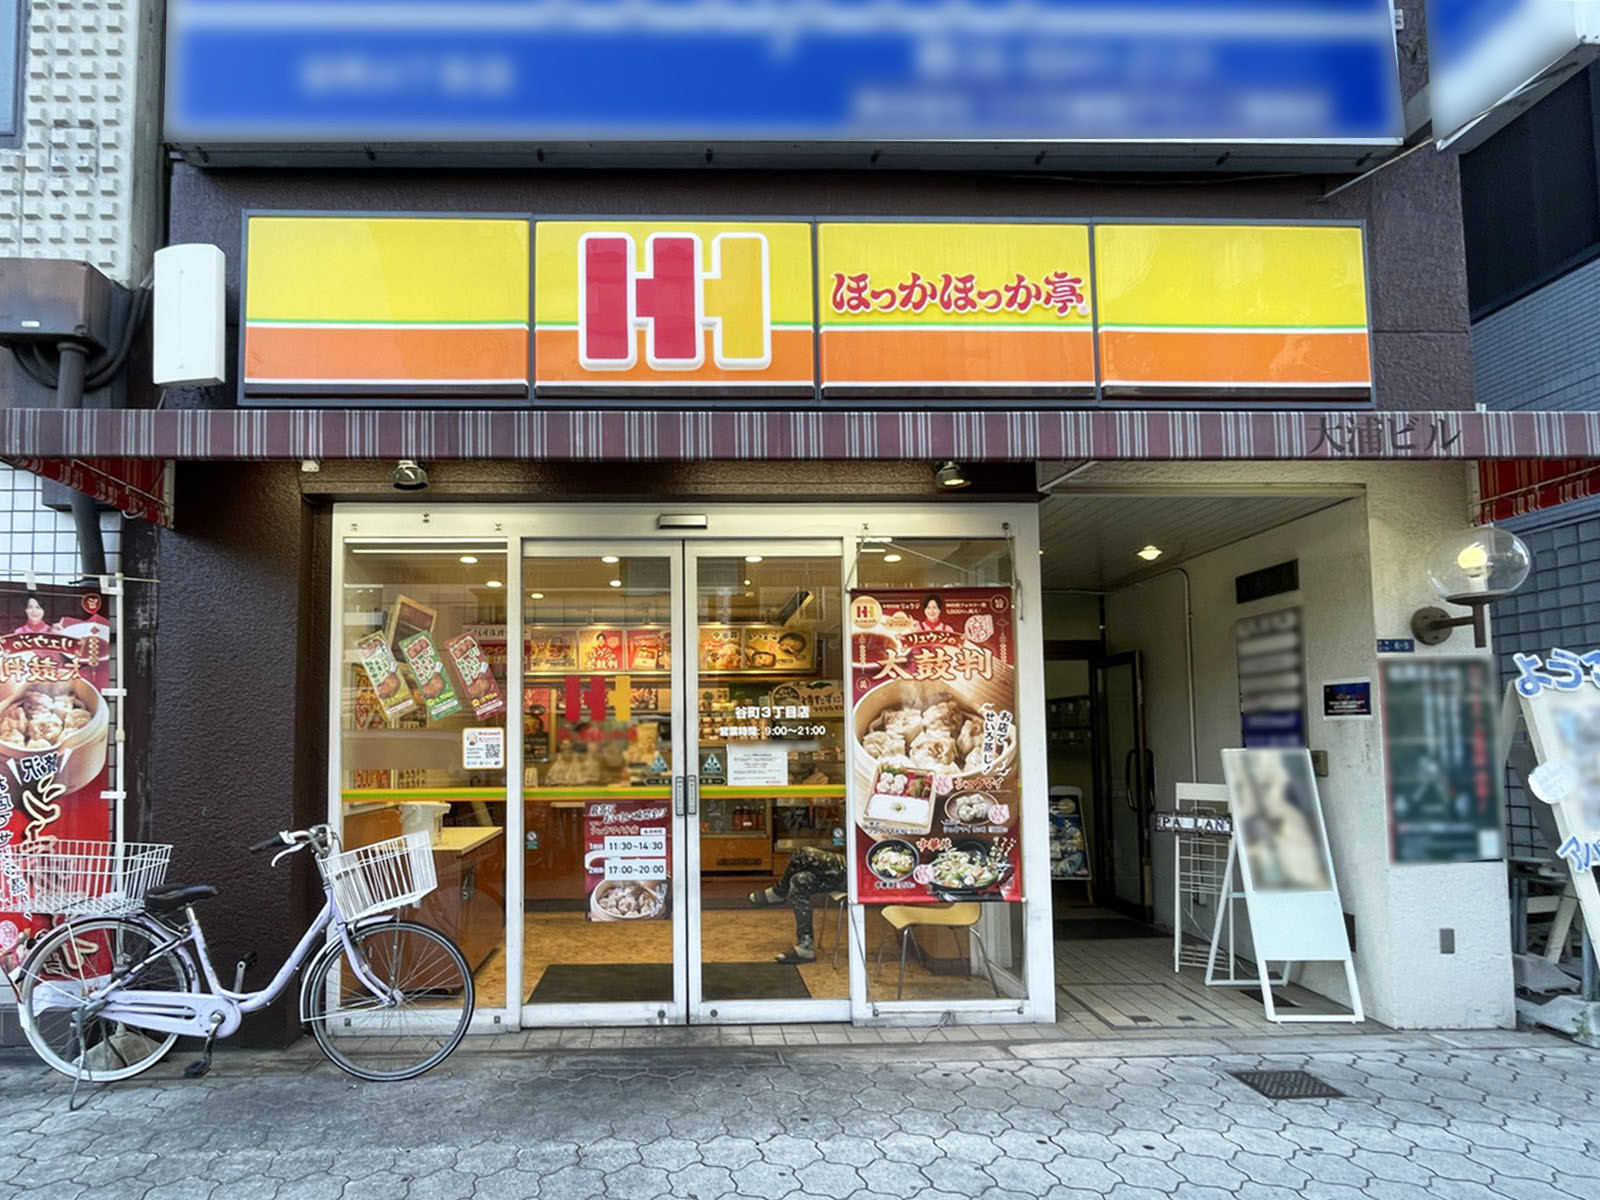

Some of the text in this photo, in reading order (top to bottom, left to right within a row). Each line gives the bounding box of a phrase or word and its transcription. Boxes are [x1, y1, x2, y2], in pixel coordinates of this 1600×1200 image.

[832, 271, 1087, 316] ほっかほっか亭
[1306, 416, 1461, 454] 大浦ビル
[907, 632, 957, 645] リュウジの
[872, 647, 994, 681] 太鼓判
[735, 706, 810, 719] 谷町3丁目店
[996, 711, 1012, 744] お店で
